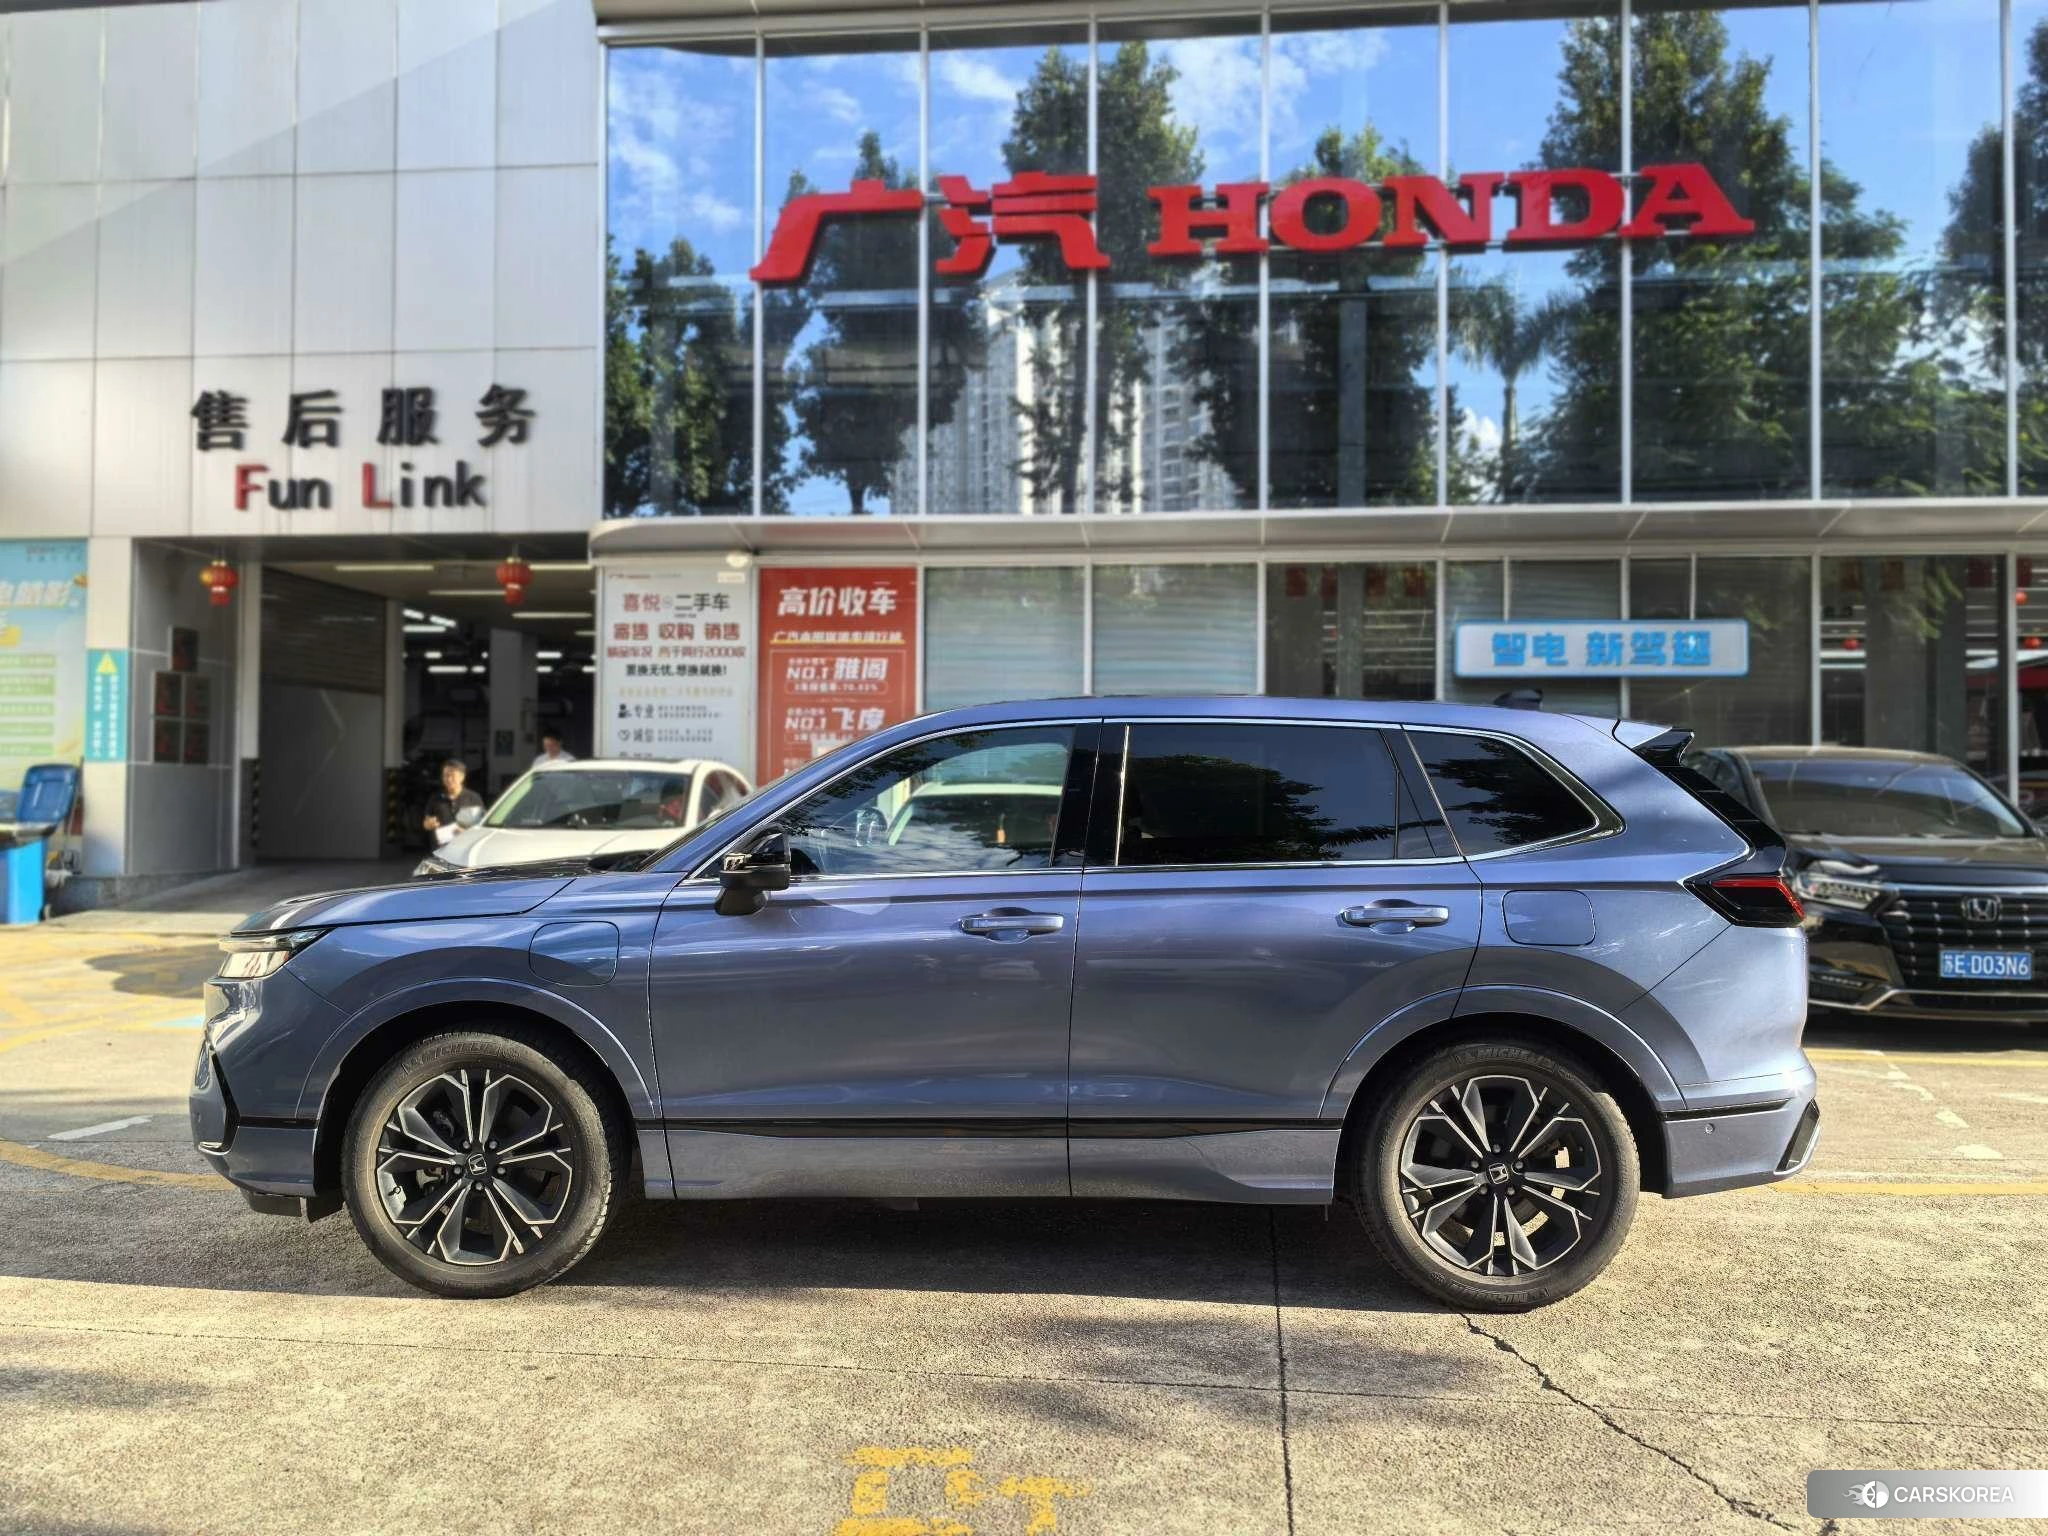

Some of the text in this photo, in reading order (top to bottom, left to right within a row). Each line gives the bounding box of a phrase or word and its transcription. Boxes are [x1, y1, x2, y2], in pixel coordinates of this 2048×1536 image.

[749, 163, 1756, 282] 广汽 HONDA
[190, 383, 537, 451] 售后服务
[234, 460, 488, 511] Fun Link
[674, 594, 730, 612] 二手车
[777, 586, 898, 617] 高价收车
[658, 623, 695, 641] 收购
[1492, 631, 1568, 666] 智电
[786, 667, 829, 680] NO.1
[785, 717, 826, 730] NO.1
